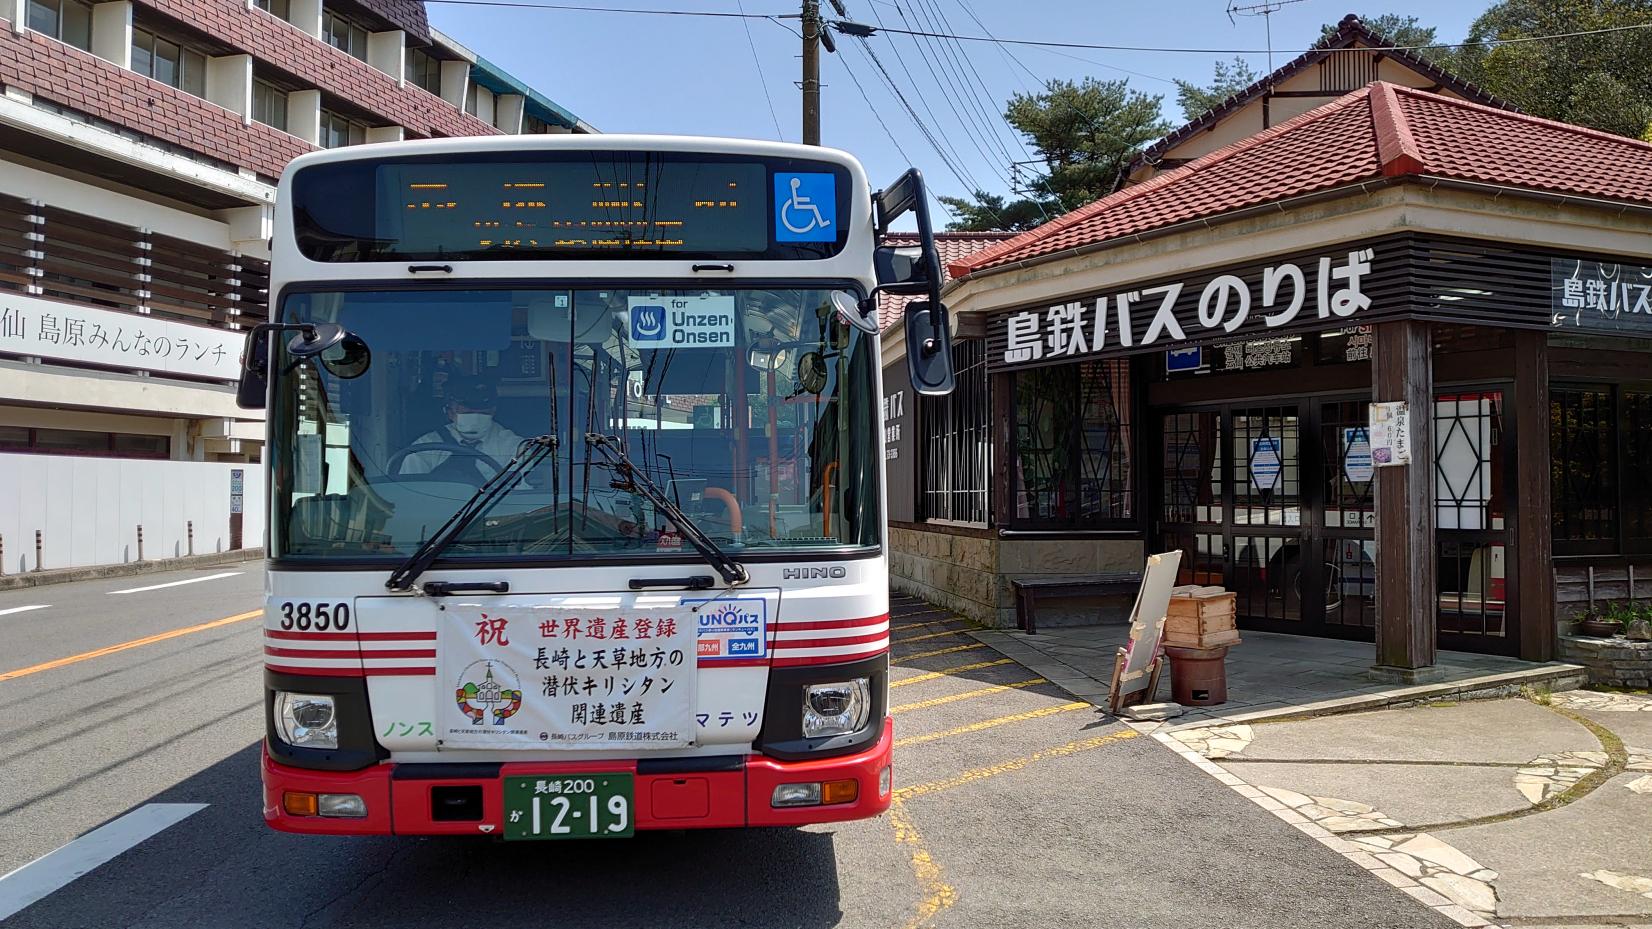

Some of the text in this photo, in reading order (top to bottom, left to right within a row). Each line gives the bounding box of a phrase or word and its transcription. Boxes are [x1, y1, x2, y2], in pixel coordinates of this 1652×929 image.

[672, 299, 688, 309] for
[1004, 248, 1374, 363] 島鉄バスのりば
[1562, 278, 1652, 314] 島鉄バス
[672, 311, 729, 327] Unzen
[38, 314, 227, 366] 島原みんなのランチ
[672, 328, 730, 344] Onsen
[1245, 351, 1292, 367] 公共汽车站
[783, 566, 846, 579] HINO
[280, 602, 350, 631] 3850
[698, 611, 759, 626] UNQパス
[474, 613, 510, 647] 祝
[538, 616, 678, 640] 世界遺産登録
[731, 642, 755, 652] 全九州
[533, 647, 684, 670] 長崎と天草地方の
[542, 676, 675, 698] 潜伏キリシタン
[571, 701, 646, 725] 関連遺産
[383, 721, 434, 738] ノンス
[550, 731, 679, 741] 長崎バスグループ 島原鉄道株式会社
[509, 795, 628, 835] が 12-19
